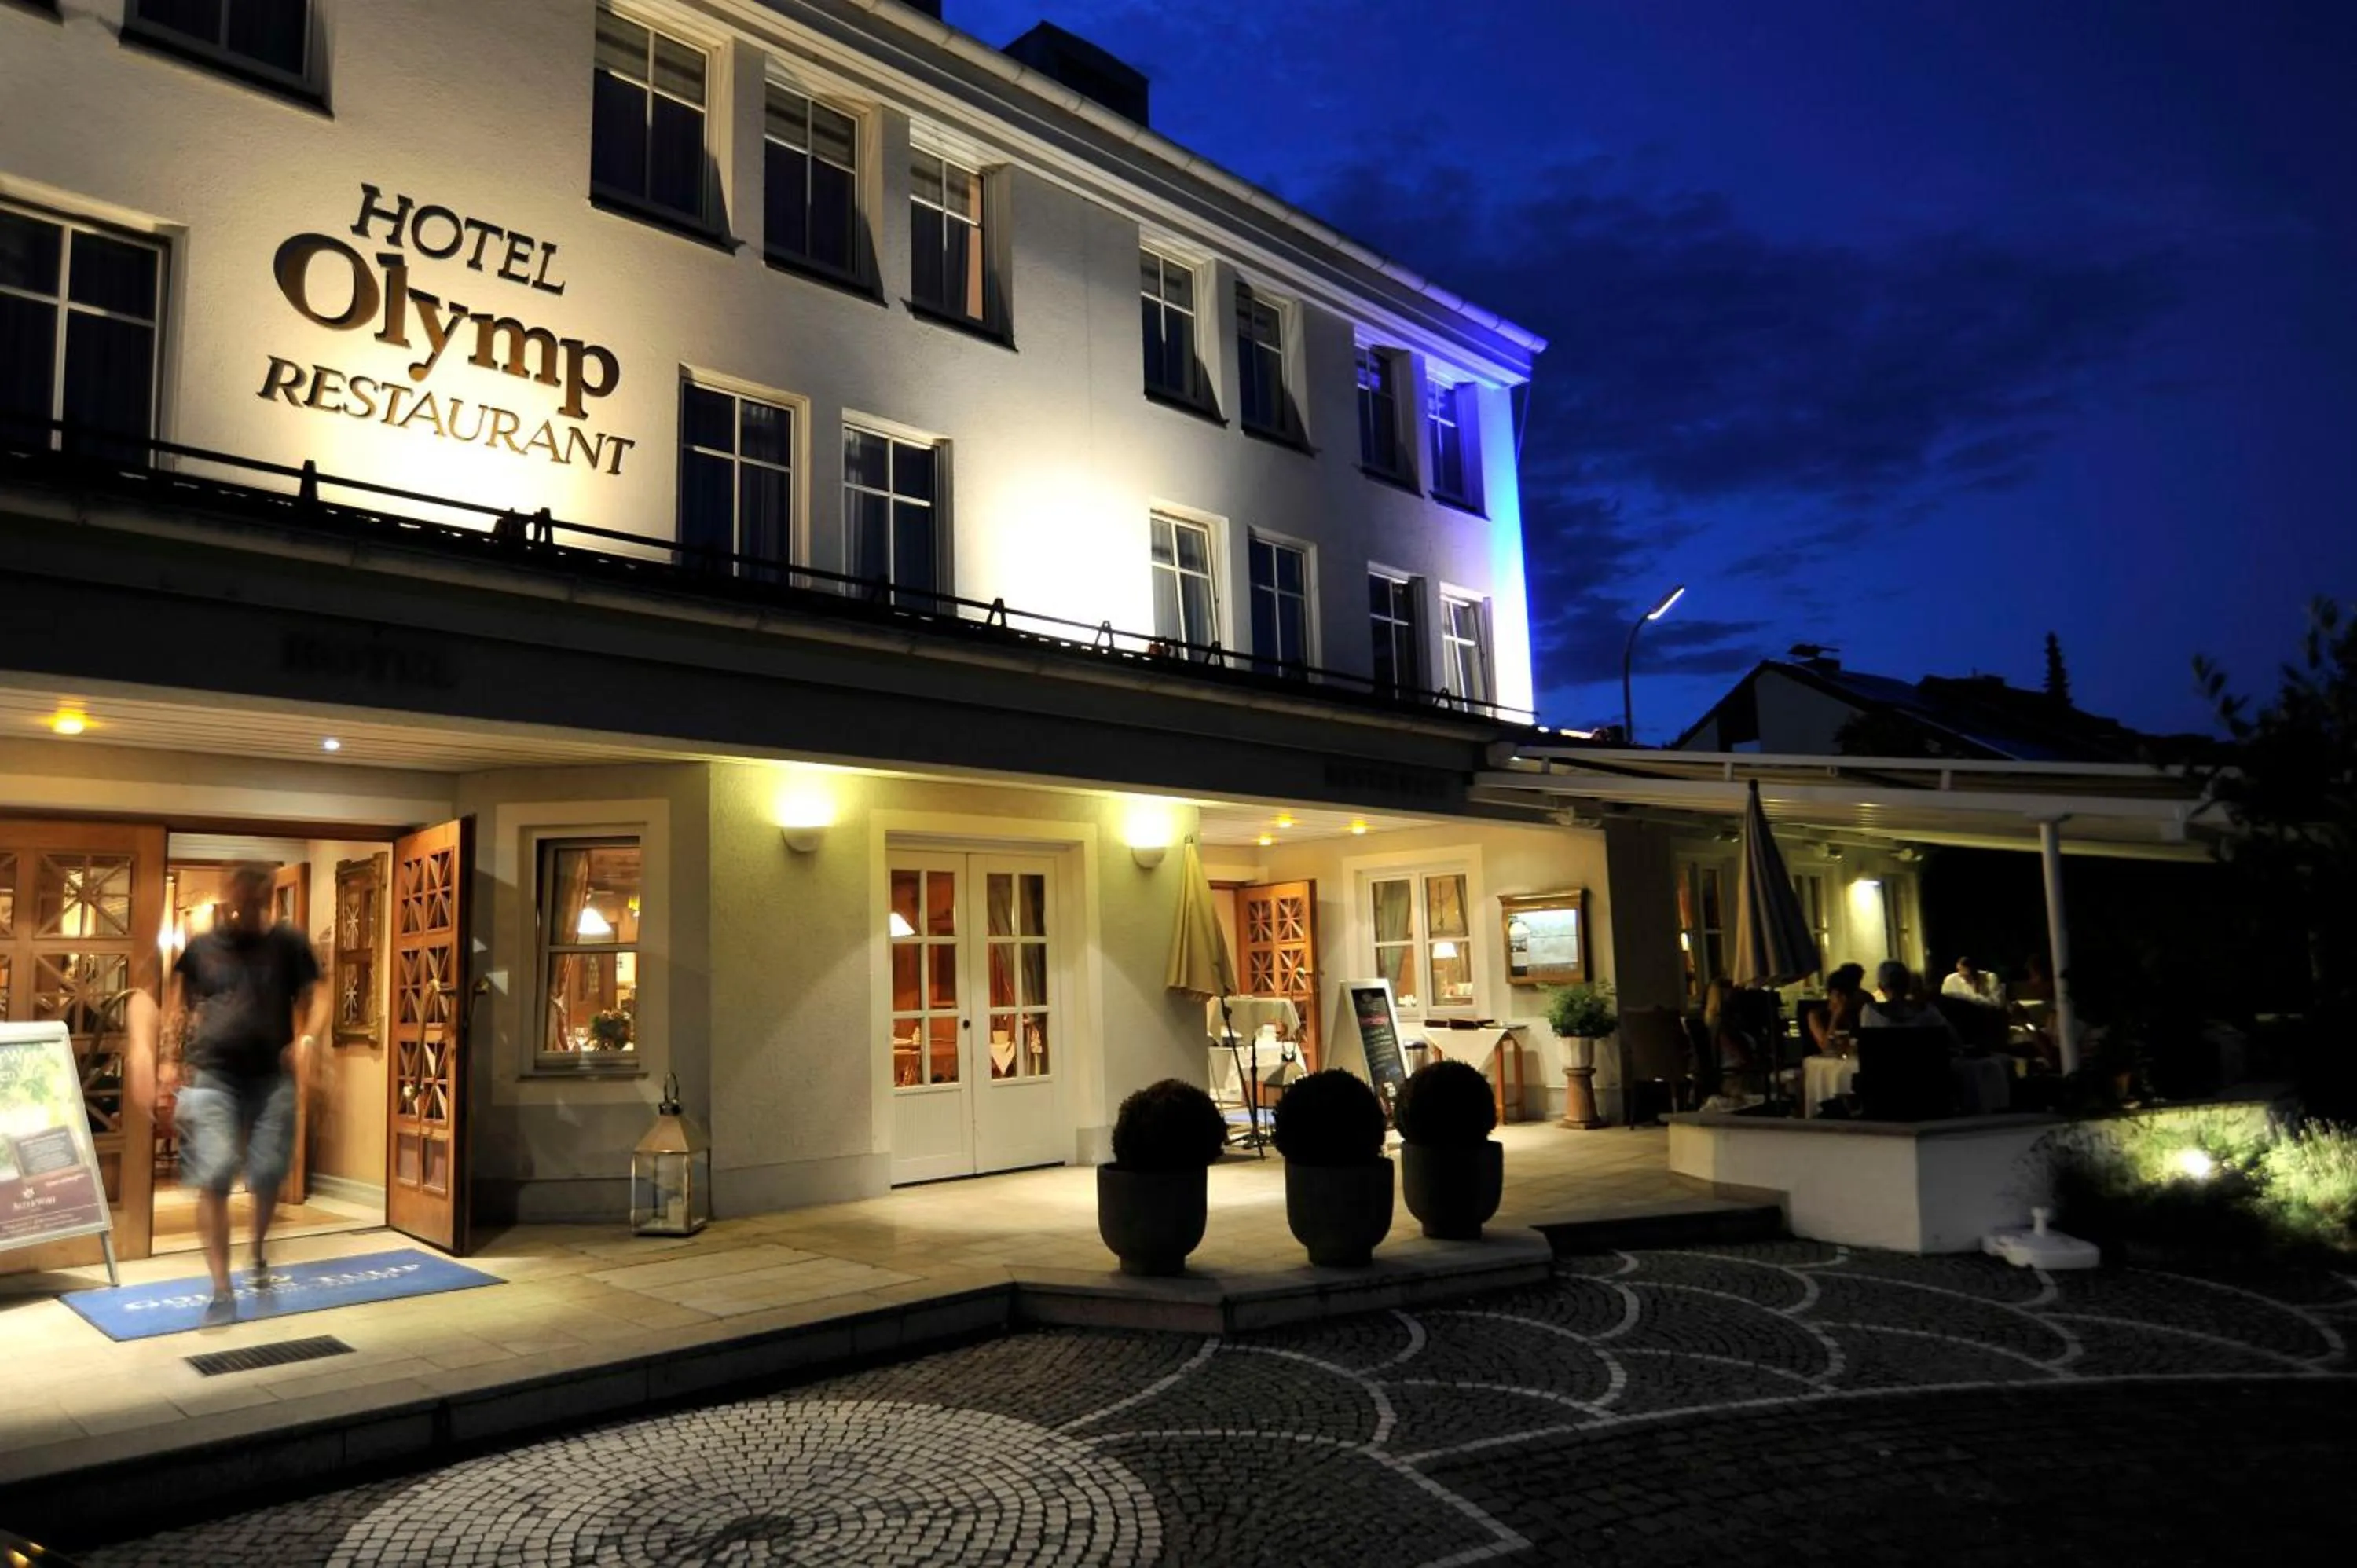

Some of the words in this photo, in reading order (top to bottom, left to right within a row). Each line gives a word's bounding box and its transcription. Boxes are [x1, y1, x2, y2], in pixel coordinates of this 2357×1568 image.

[350, 182, 566, 295] HOTEL
[273, 232, 620, 419] Olymp
[256, 354, 635, 475] RESTAURANT
